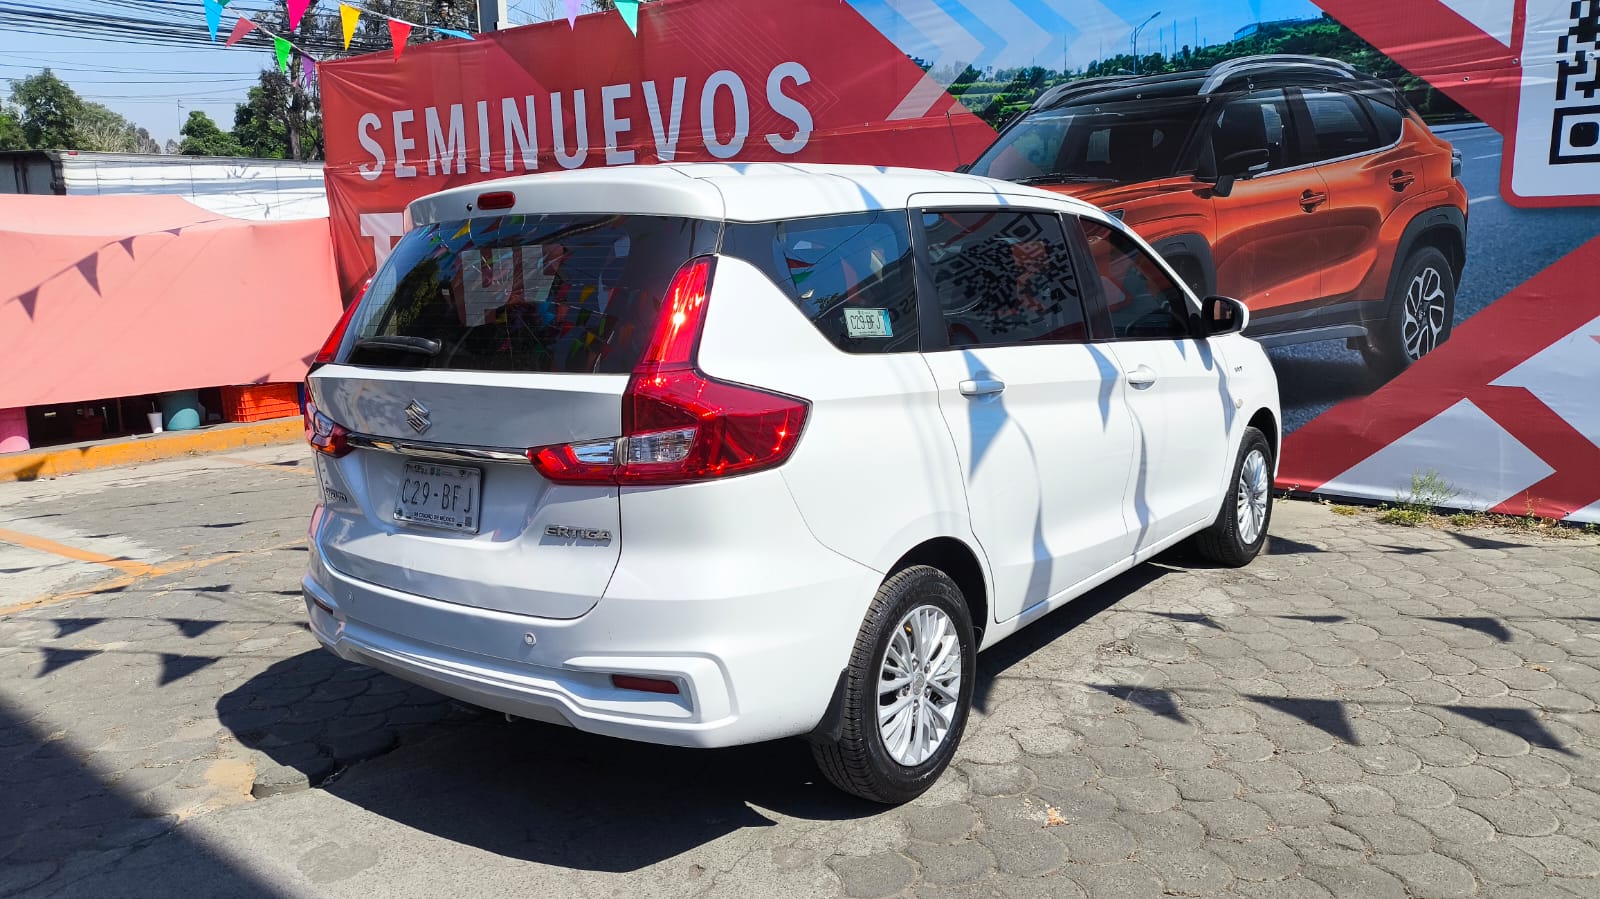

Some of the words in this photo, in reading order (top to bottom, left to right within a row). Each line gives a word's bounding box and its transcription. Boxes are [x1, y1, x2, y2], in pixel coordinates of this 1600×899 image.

[357, 61, 815, 181] SEMINUEVOS
[401, 478, 472, 513] C29-BFJ
[544, 524, 612, 540] ERTIGA
